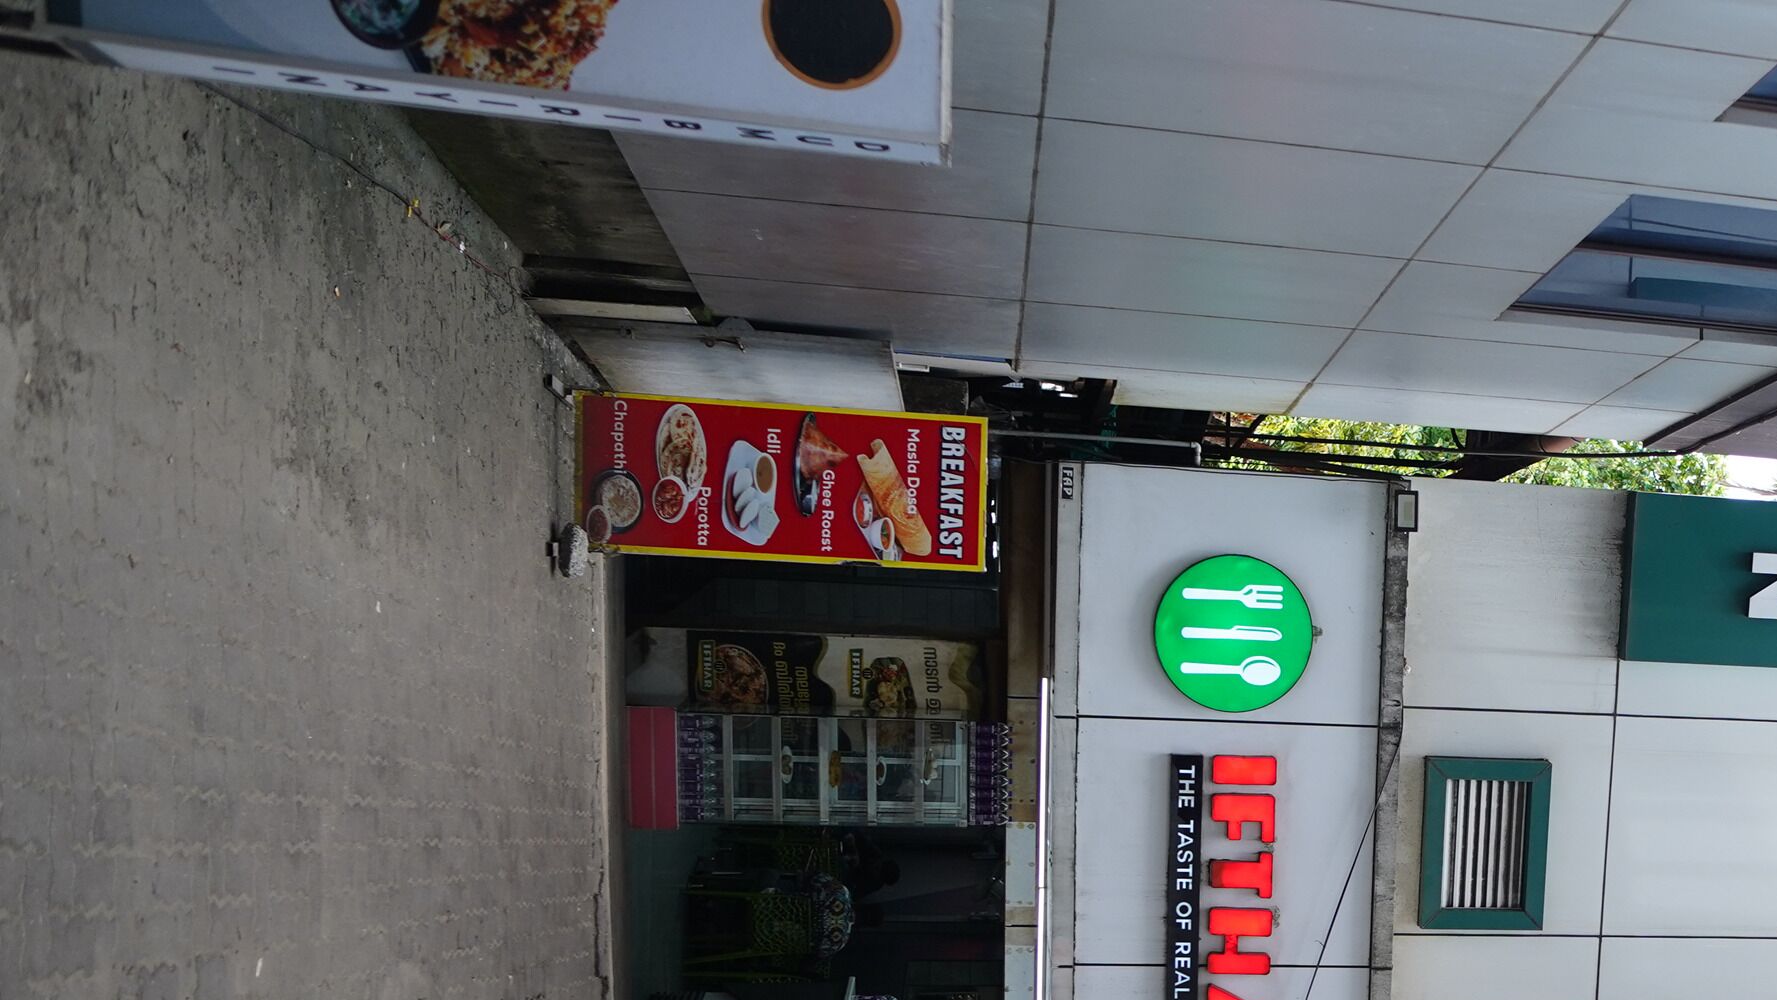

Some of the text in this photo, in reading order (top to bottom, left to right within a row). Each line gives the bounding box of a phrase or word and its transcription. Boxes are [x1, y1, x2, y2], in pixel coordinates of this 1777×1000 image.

[212, 65, 891, 153] DUM BIRIYANI
[611, 399, 628, 475] Chapathi
[766, 428, 782, 454] Idli
[906, 428, 920, 515] Masla Dosa
[938, 426, 966, 560] BREAKFAST
[697, 486, 711, 546] Porotta
[821, 469, 835, 552] Ghee Roast
[701, 643, 713, 690] IFTHAR
[850, 649, 862, 696] IFTHAR
[1176, 765, 1196, 808] THE
[1175, 819, 1195, 890] TASTE
[1174, 901, 1193, 931] OF
[1173, 942, 1192, 999] REAL
